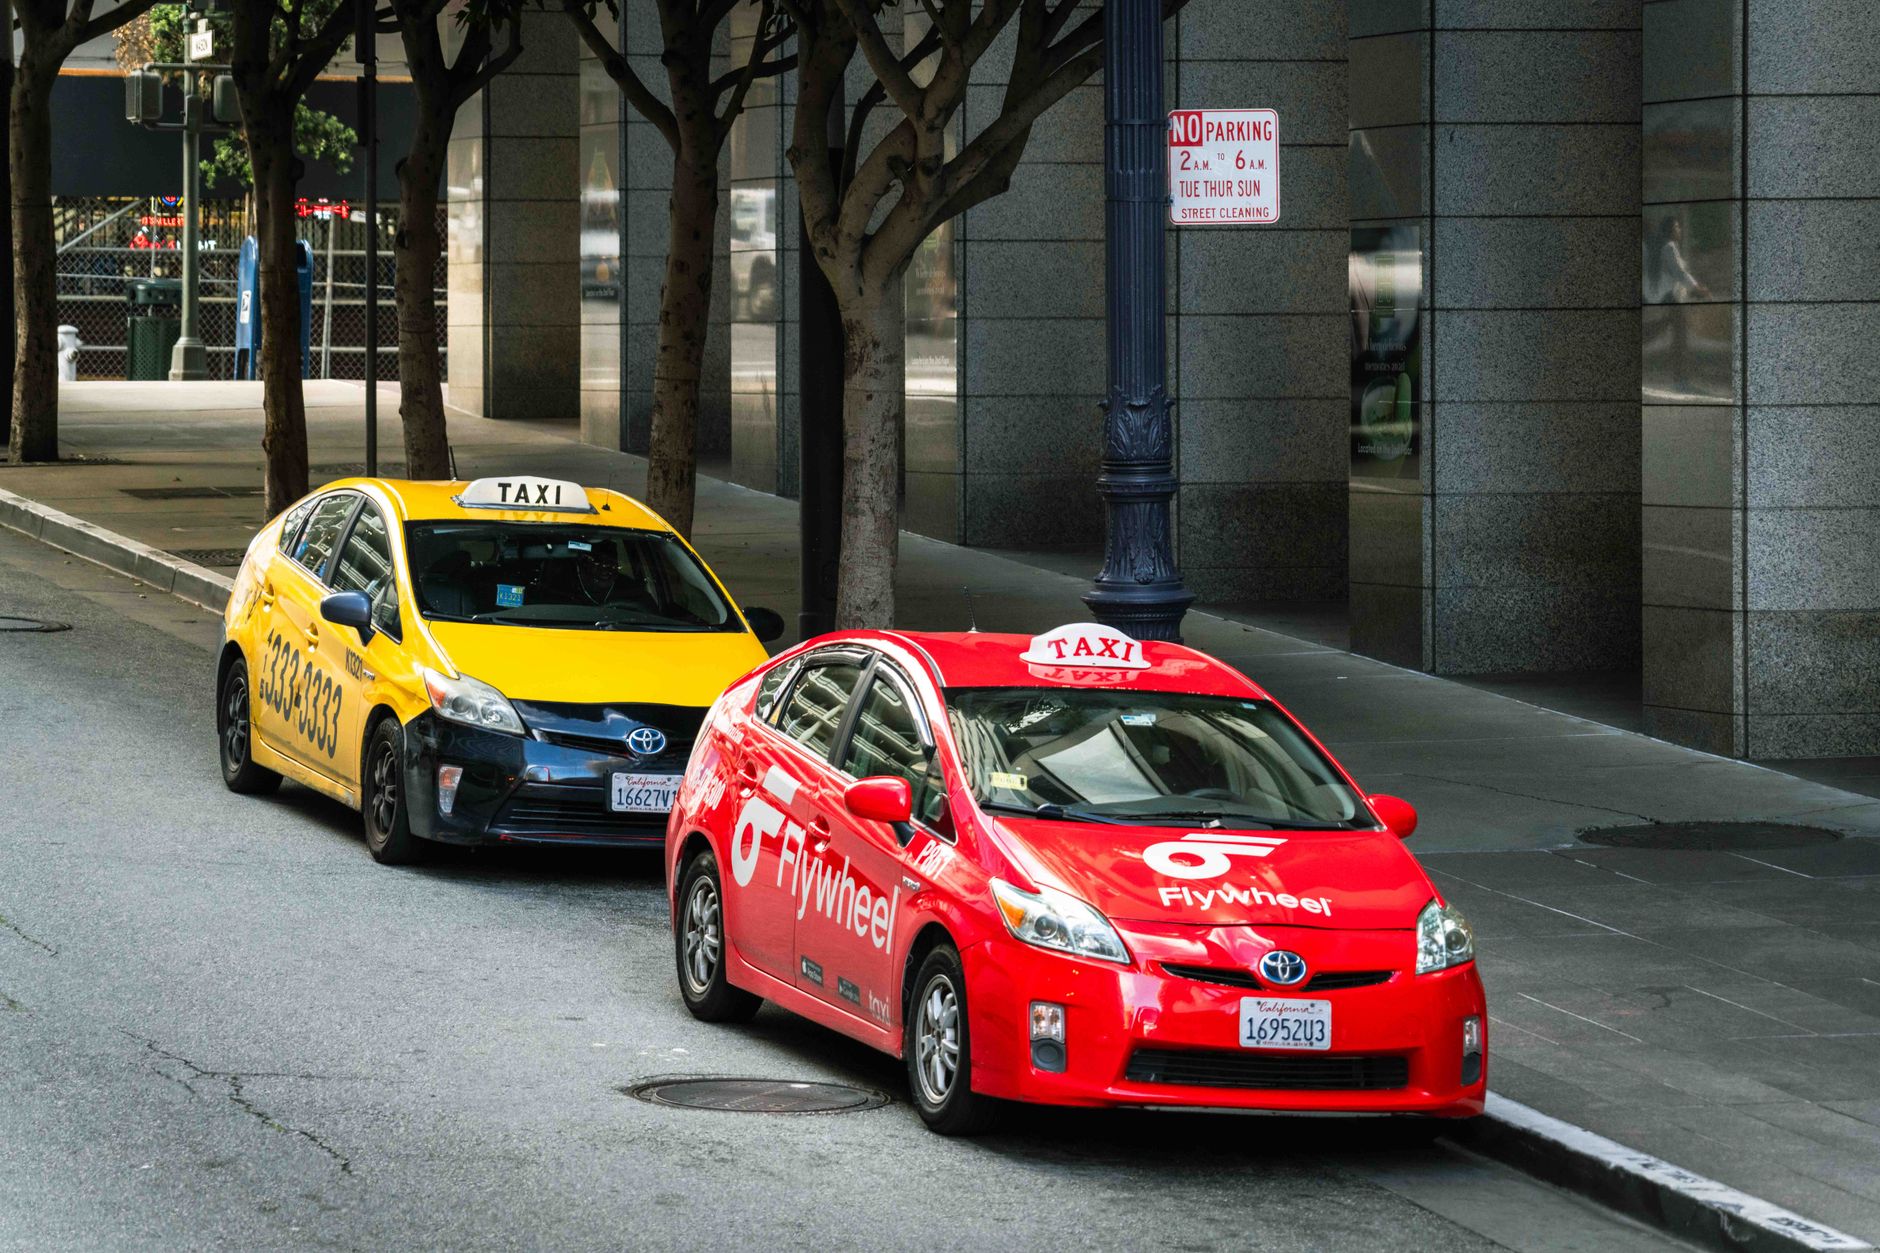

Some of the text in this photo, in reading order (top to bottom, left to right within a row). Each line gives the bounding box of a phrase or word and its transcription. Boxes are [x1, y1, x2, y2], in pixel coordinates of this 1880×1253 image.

[1172, 114, 1272, 143] NO PARKING
[1180, 149, 1268, 171] 2 A.M. TO 6 A.M.
[1180, 180, 1261, 197] TUE THUR SUN
[1181, 207, 1270, 219] STREET CLEANING
[498, 482, 561, 505] TAXI
[1047, 636, 1135, 663] TAXI
[346, 646, 363, 682] K1321
[627, 775, 671, 788] California
[776, 820, 900, 955] Flywheel
[1157, 885, 1332, 917] Flywheel
[868, 988, 891, 1027] taxi
[1259, 1000, 1314, 1017] California
[1246, 1016, 1326, 1042] 16952U3
